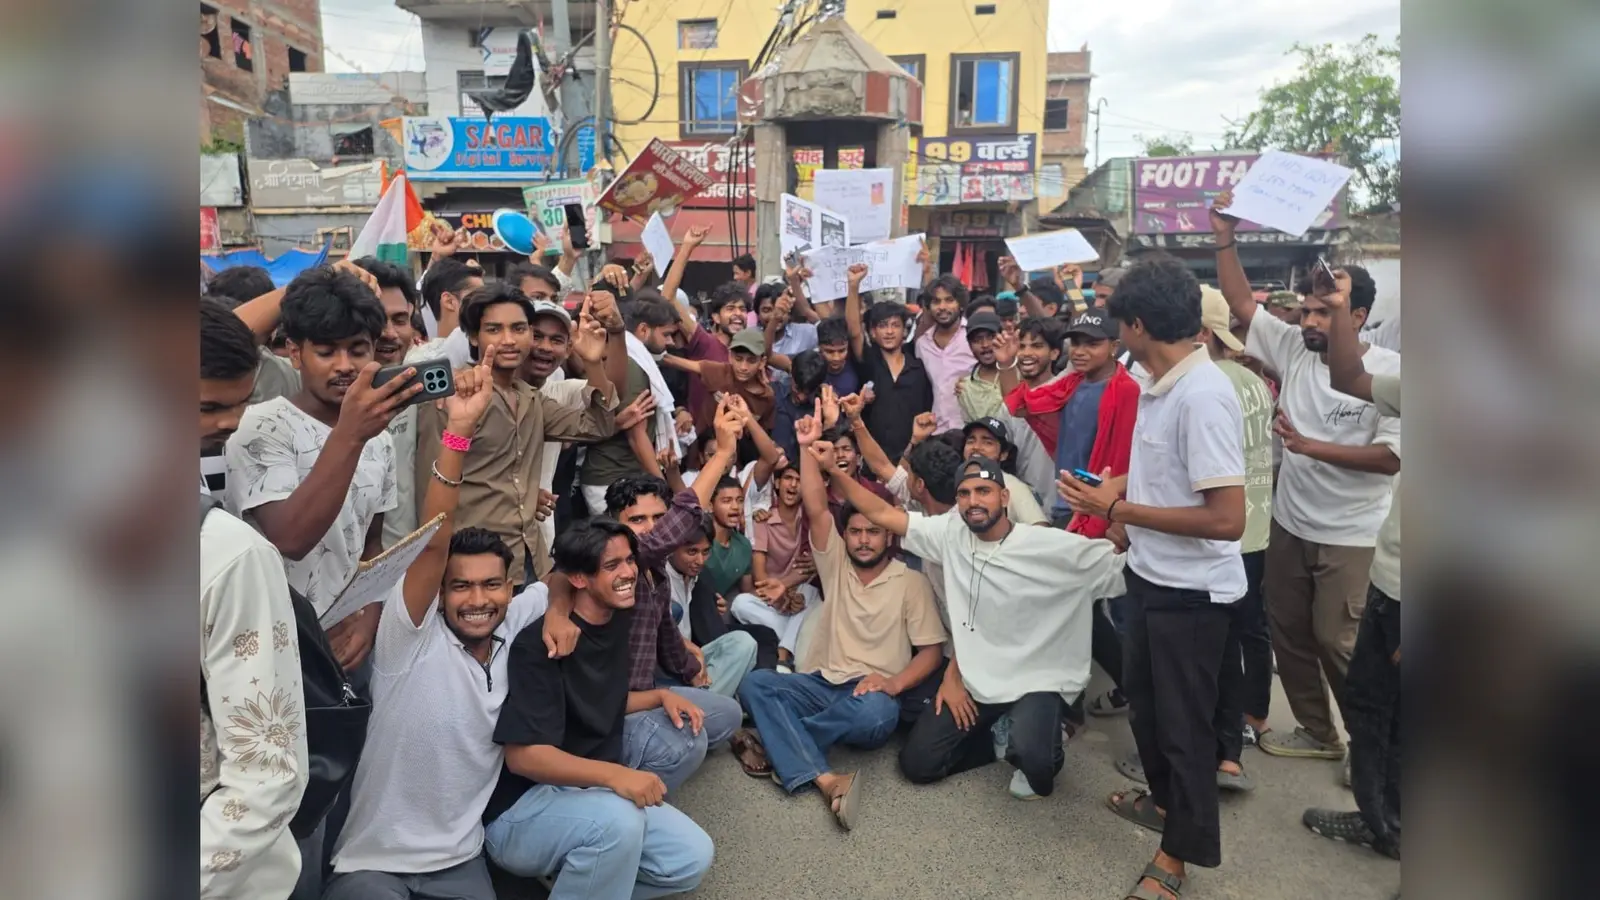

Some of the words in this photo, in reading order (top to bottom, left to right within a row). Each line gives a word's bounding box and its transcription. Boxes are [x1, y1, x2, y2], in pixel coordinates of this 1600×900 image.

[465, 124, 543, 149] SAGAR
[925, 141, 971, 162] 99
[1140, 161, 1211, 188] FOOT
[1217, 160, 1249, 187] FA
[461, 214, 494, 229] CHI
